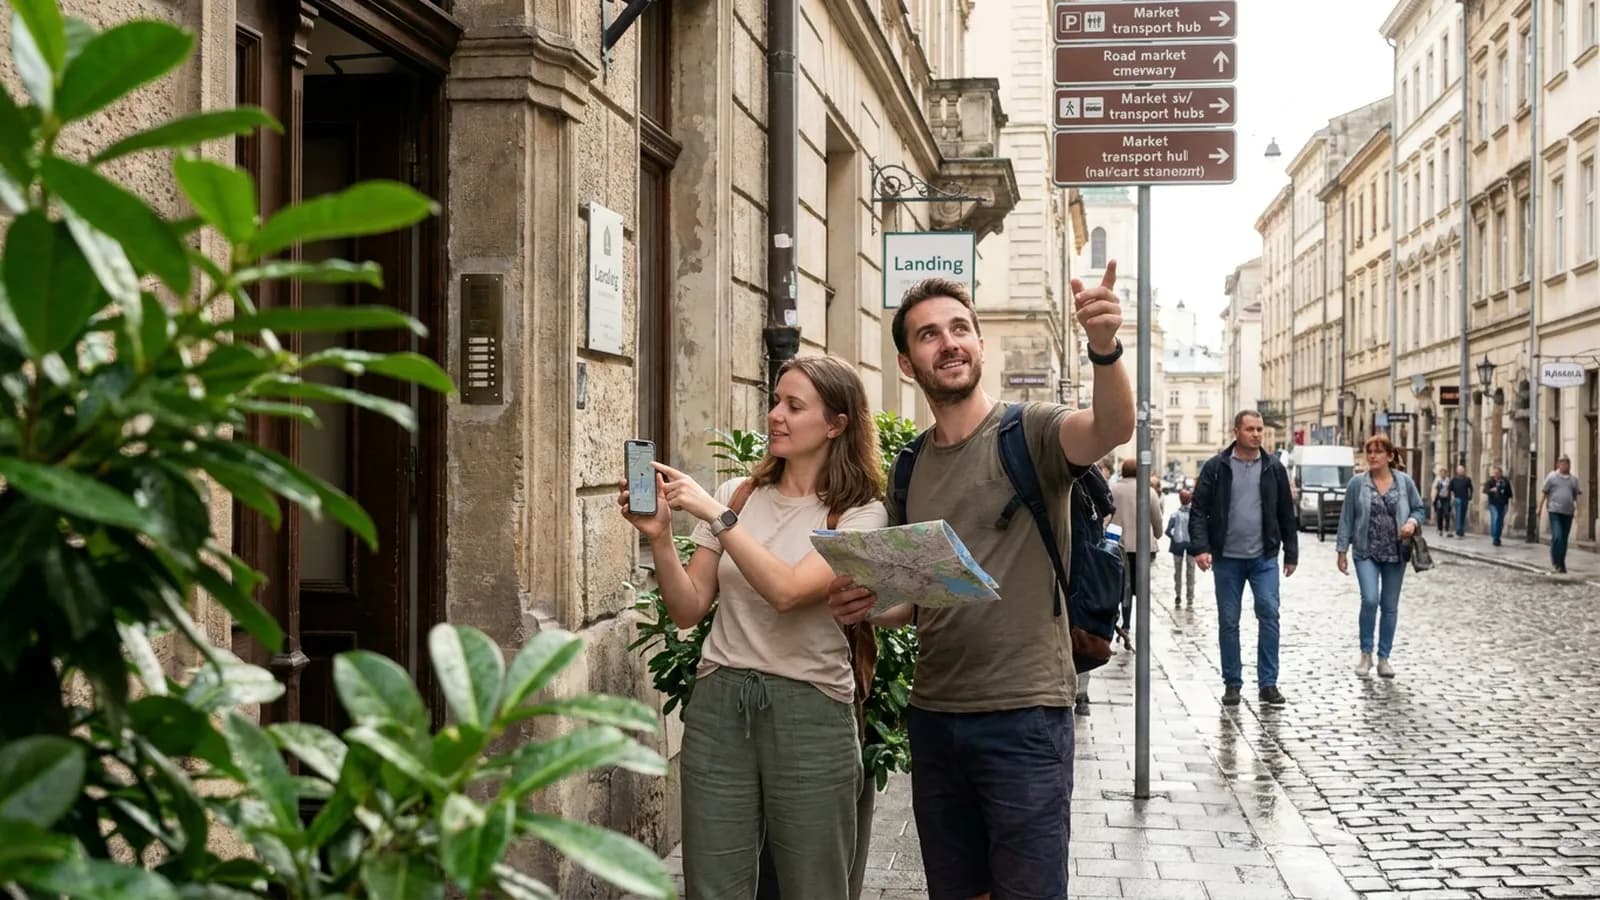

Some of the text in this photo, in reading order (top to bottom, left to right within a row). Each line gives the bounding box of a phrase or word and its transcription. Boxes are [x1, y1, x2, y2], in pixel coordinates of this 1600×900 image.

[1134, 7, 1180, 19] Market
[1112, 21, 1202, 36] transport hub
[1103, 49, 1186, 62] Road market
[1121, 93, 1167, 104] Market
[1109, 107, 1205, 122] transport hubs
[1122, 136, 1169, 147] Market
[1102, 151, 1162, 165] transport
[894, 255, 964, 275] Landing
